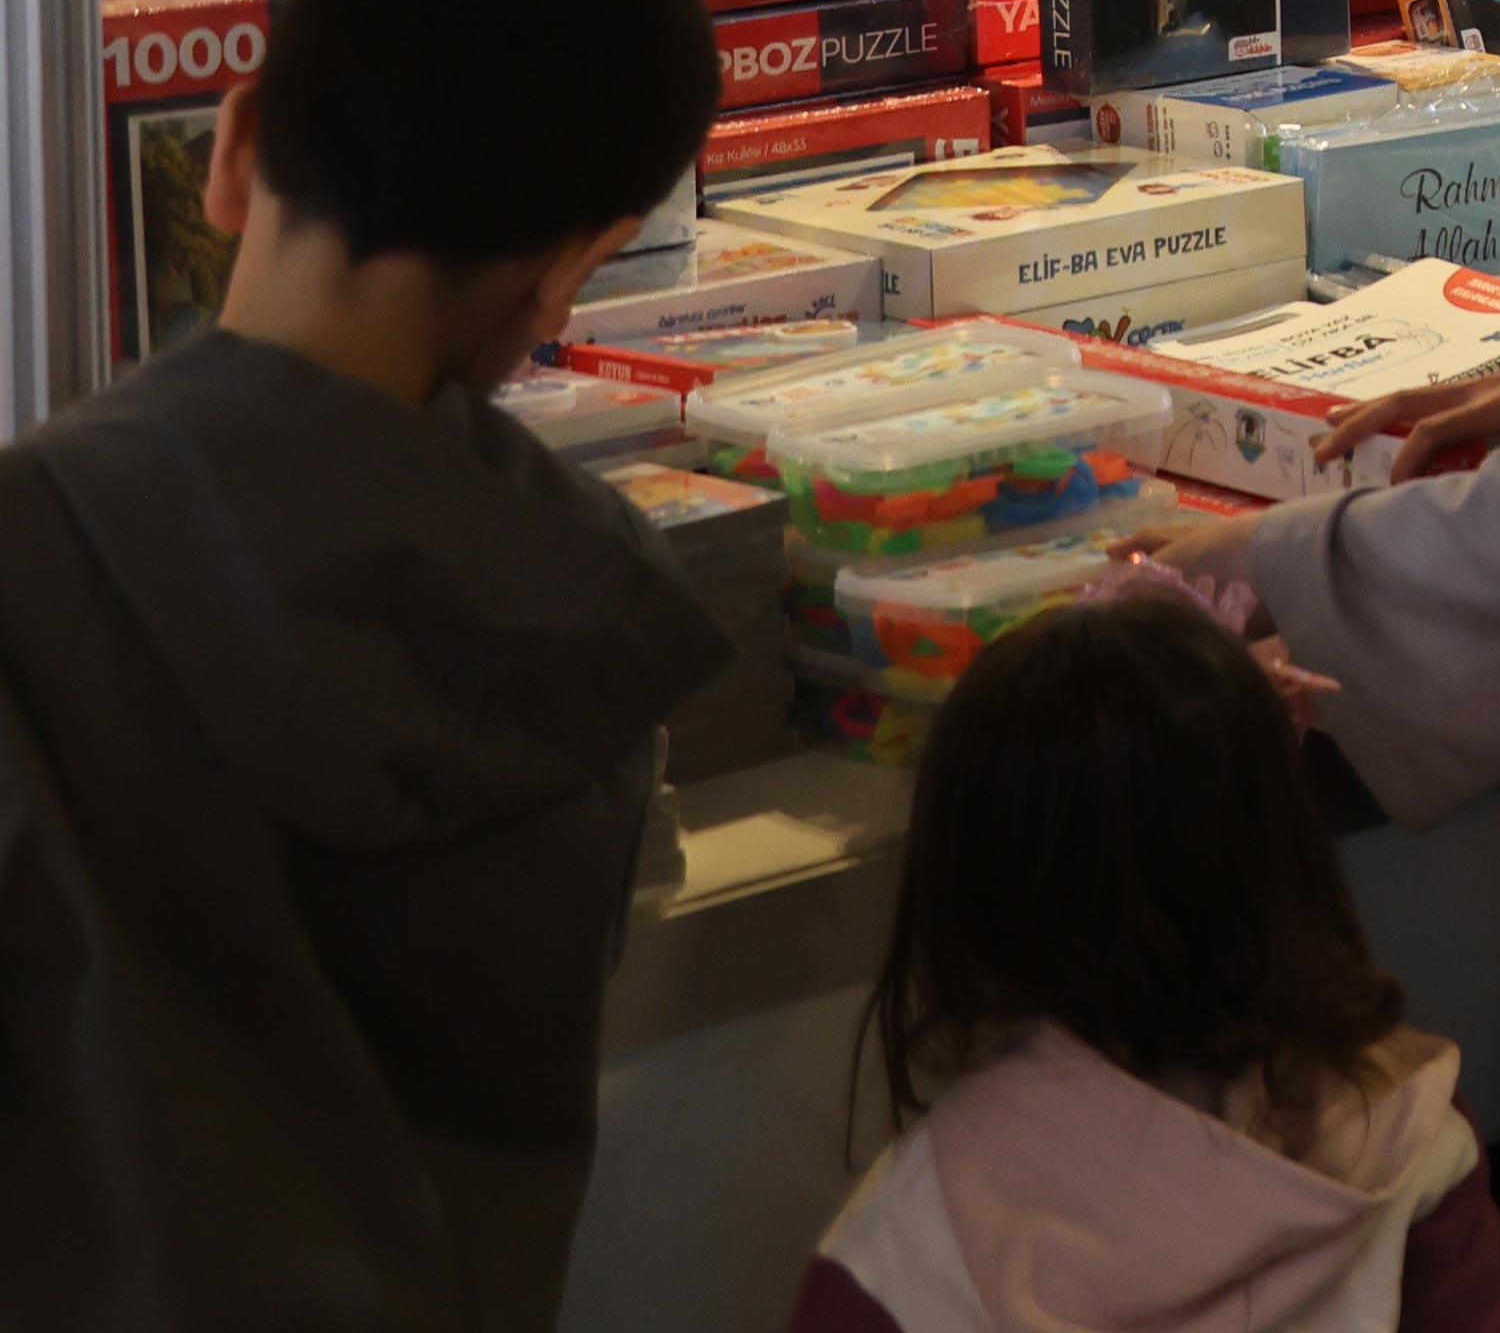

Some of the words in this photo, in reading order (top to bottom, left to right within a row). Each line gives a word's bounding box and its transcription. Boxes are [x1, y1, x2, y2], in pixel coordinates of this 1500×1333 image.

[103, 21, 266, 89] 1000
[821, 22, 939, 69] PUZZLE
[706, 148, 728, 165] Kız
[729, 143, 762, 163] Kulesi
[771, 136, 808, 155] 48x33
[1018, 250, 1099, 286] ELİF-BA
[1106, 238, 1147, 268] EVA
[1154, 225, 1228, 258] PUZZLE
